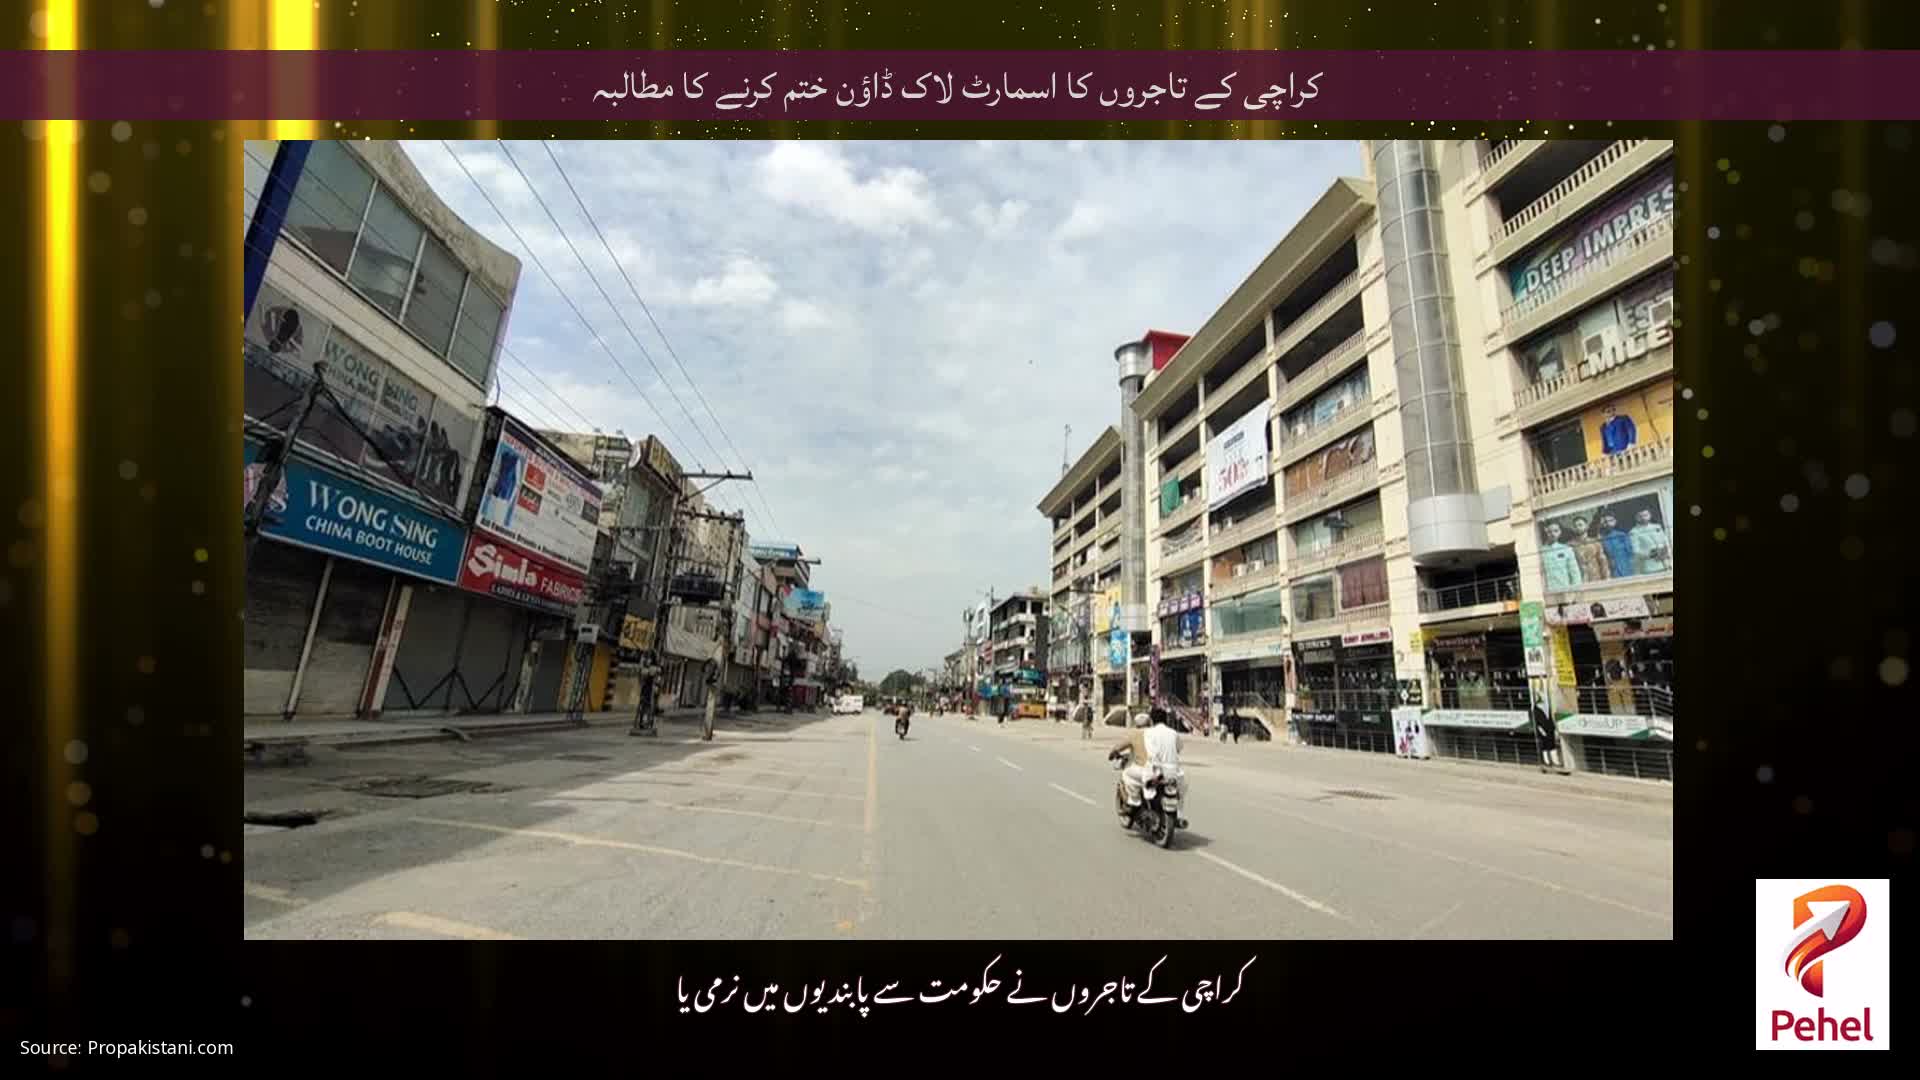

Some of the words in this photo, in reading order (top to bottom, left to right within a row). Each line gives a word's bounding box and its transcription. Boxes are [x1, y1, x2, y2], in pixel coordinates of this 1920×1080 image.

[1526, 246, 1577, 294] DEEP
[308, 480, 389, 531] WONG
[390, 512, 440, 549] SING
[305, 514, 353, 541] CHINA
[355, 530, 393, 553] BOOT
[394, 543, 433, 566] HOUSE
[467, 543, 538, 587] Simla
